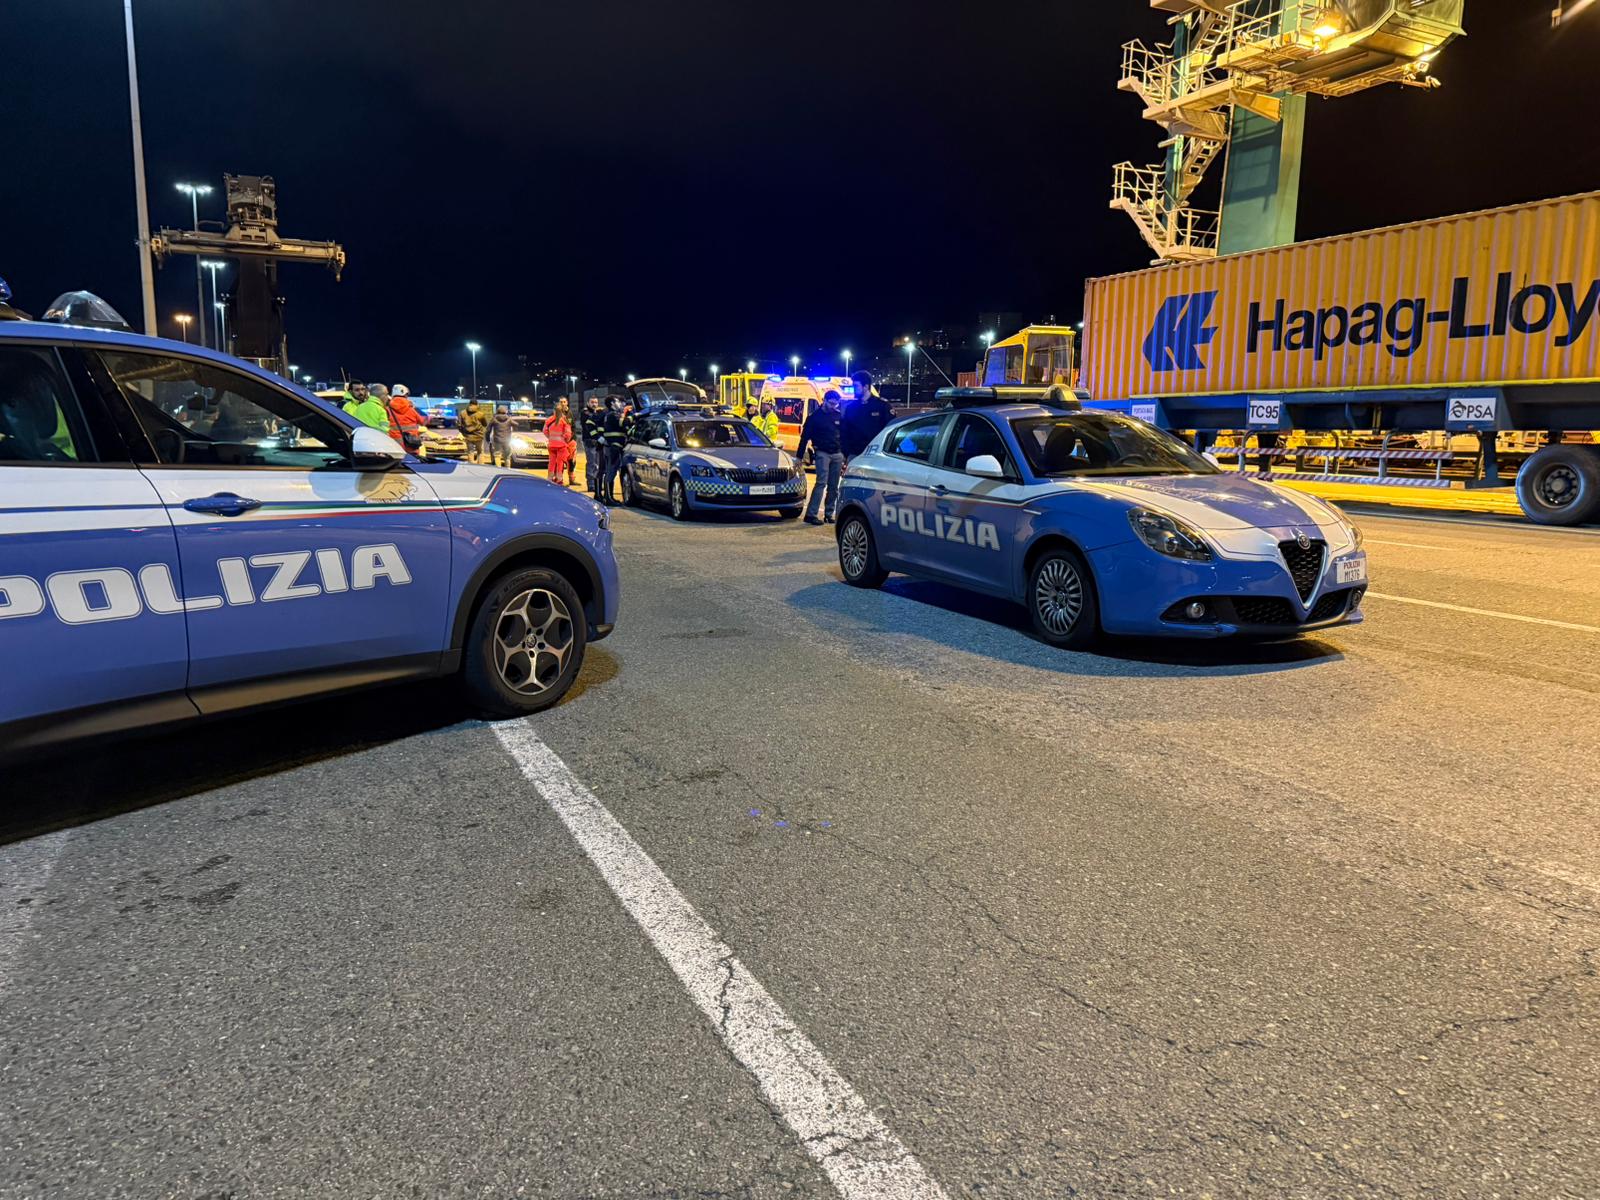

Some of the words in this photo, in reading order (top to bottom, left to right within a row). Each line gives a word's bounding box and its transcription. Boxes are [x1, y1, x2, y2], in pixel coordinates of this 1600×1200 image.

[1247, 272, 1600, 361] Hapag-Lloy
[1250, 405, 1279, 419] TC95
[1467, 405, 1493, 418] PSA
[881, 503, 1000, 551] POLIZIA
